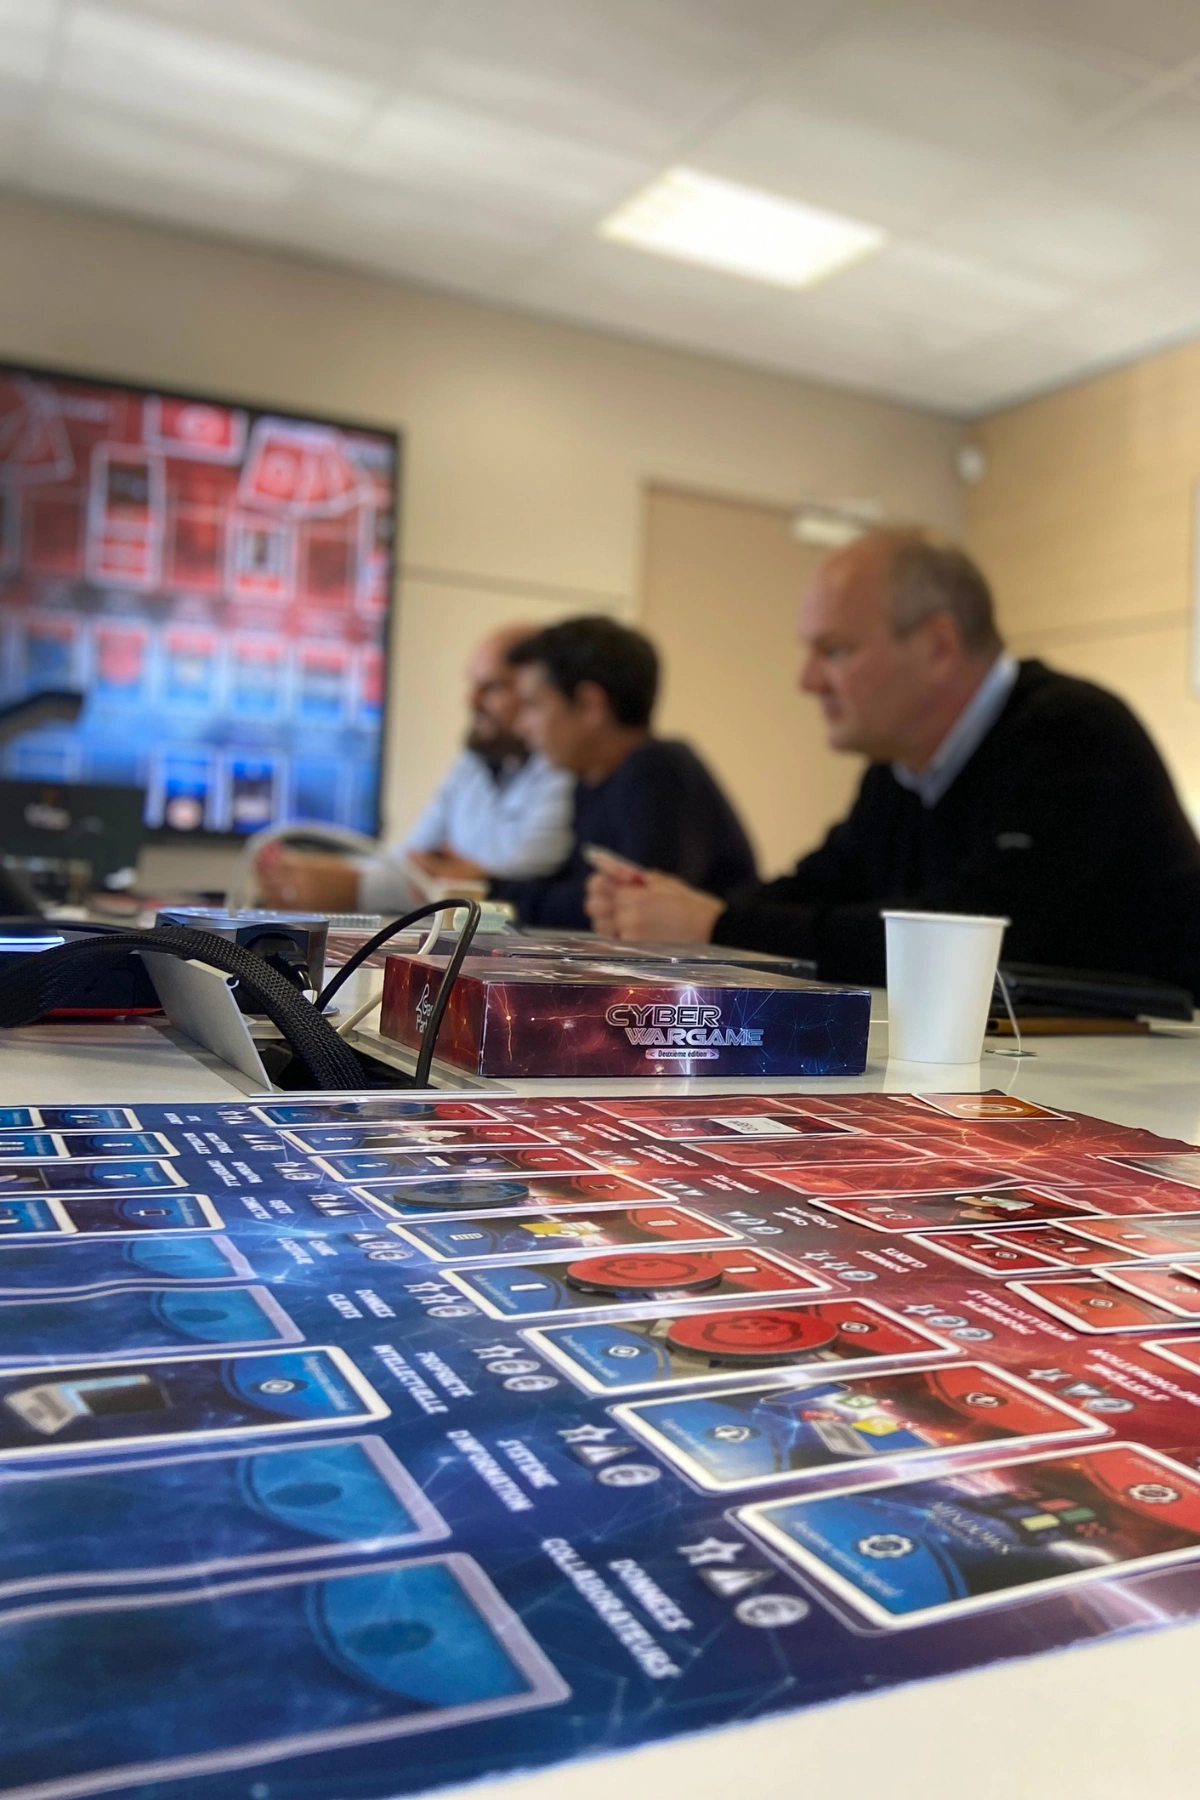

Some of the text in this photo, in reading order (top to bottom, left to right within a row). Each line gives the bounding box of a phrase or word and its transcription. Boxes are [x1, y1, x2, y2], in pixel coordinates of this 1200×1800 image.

[605, 1004, 722, 1027] CYBER
[624, 1028, 764, 1046] WARGAME
[658, 1050, 707, 1058] Deuxième édition
[880, 1246, 928, 1269] CLIENTS
[540, 1538, 682, 1679] COLLABORATEURS
